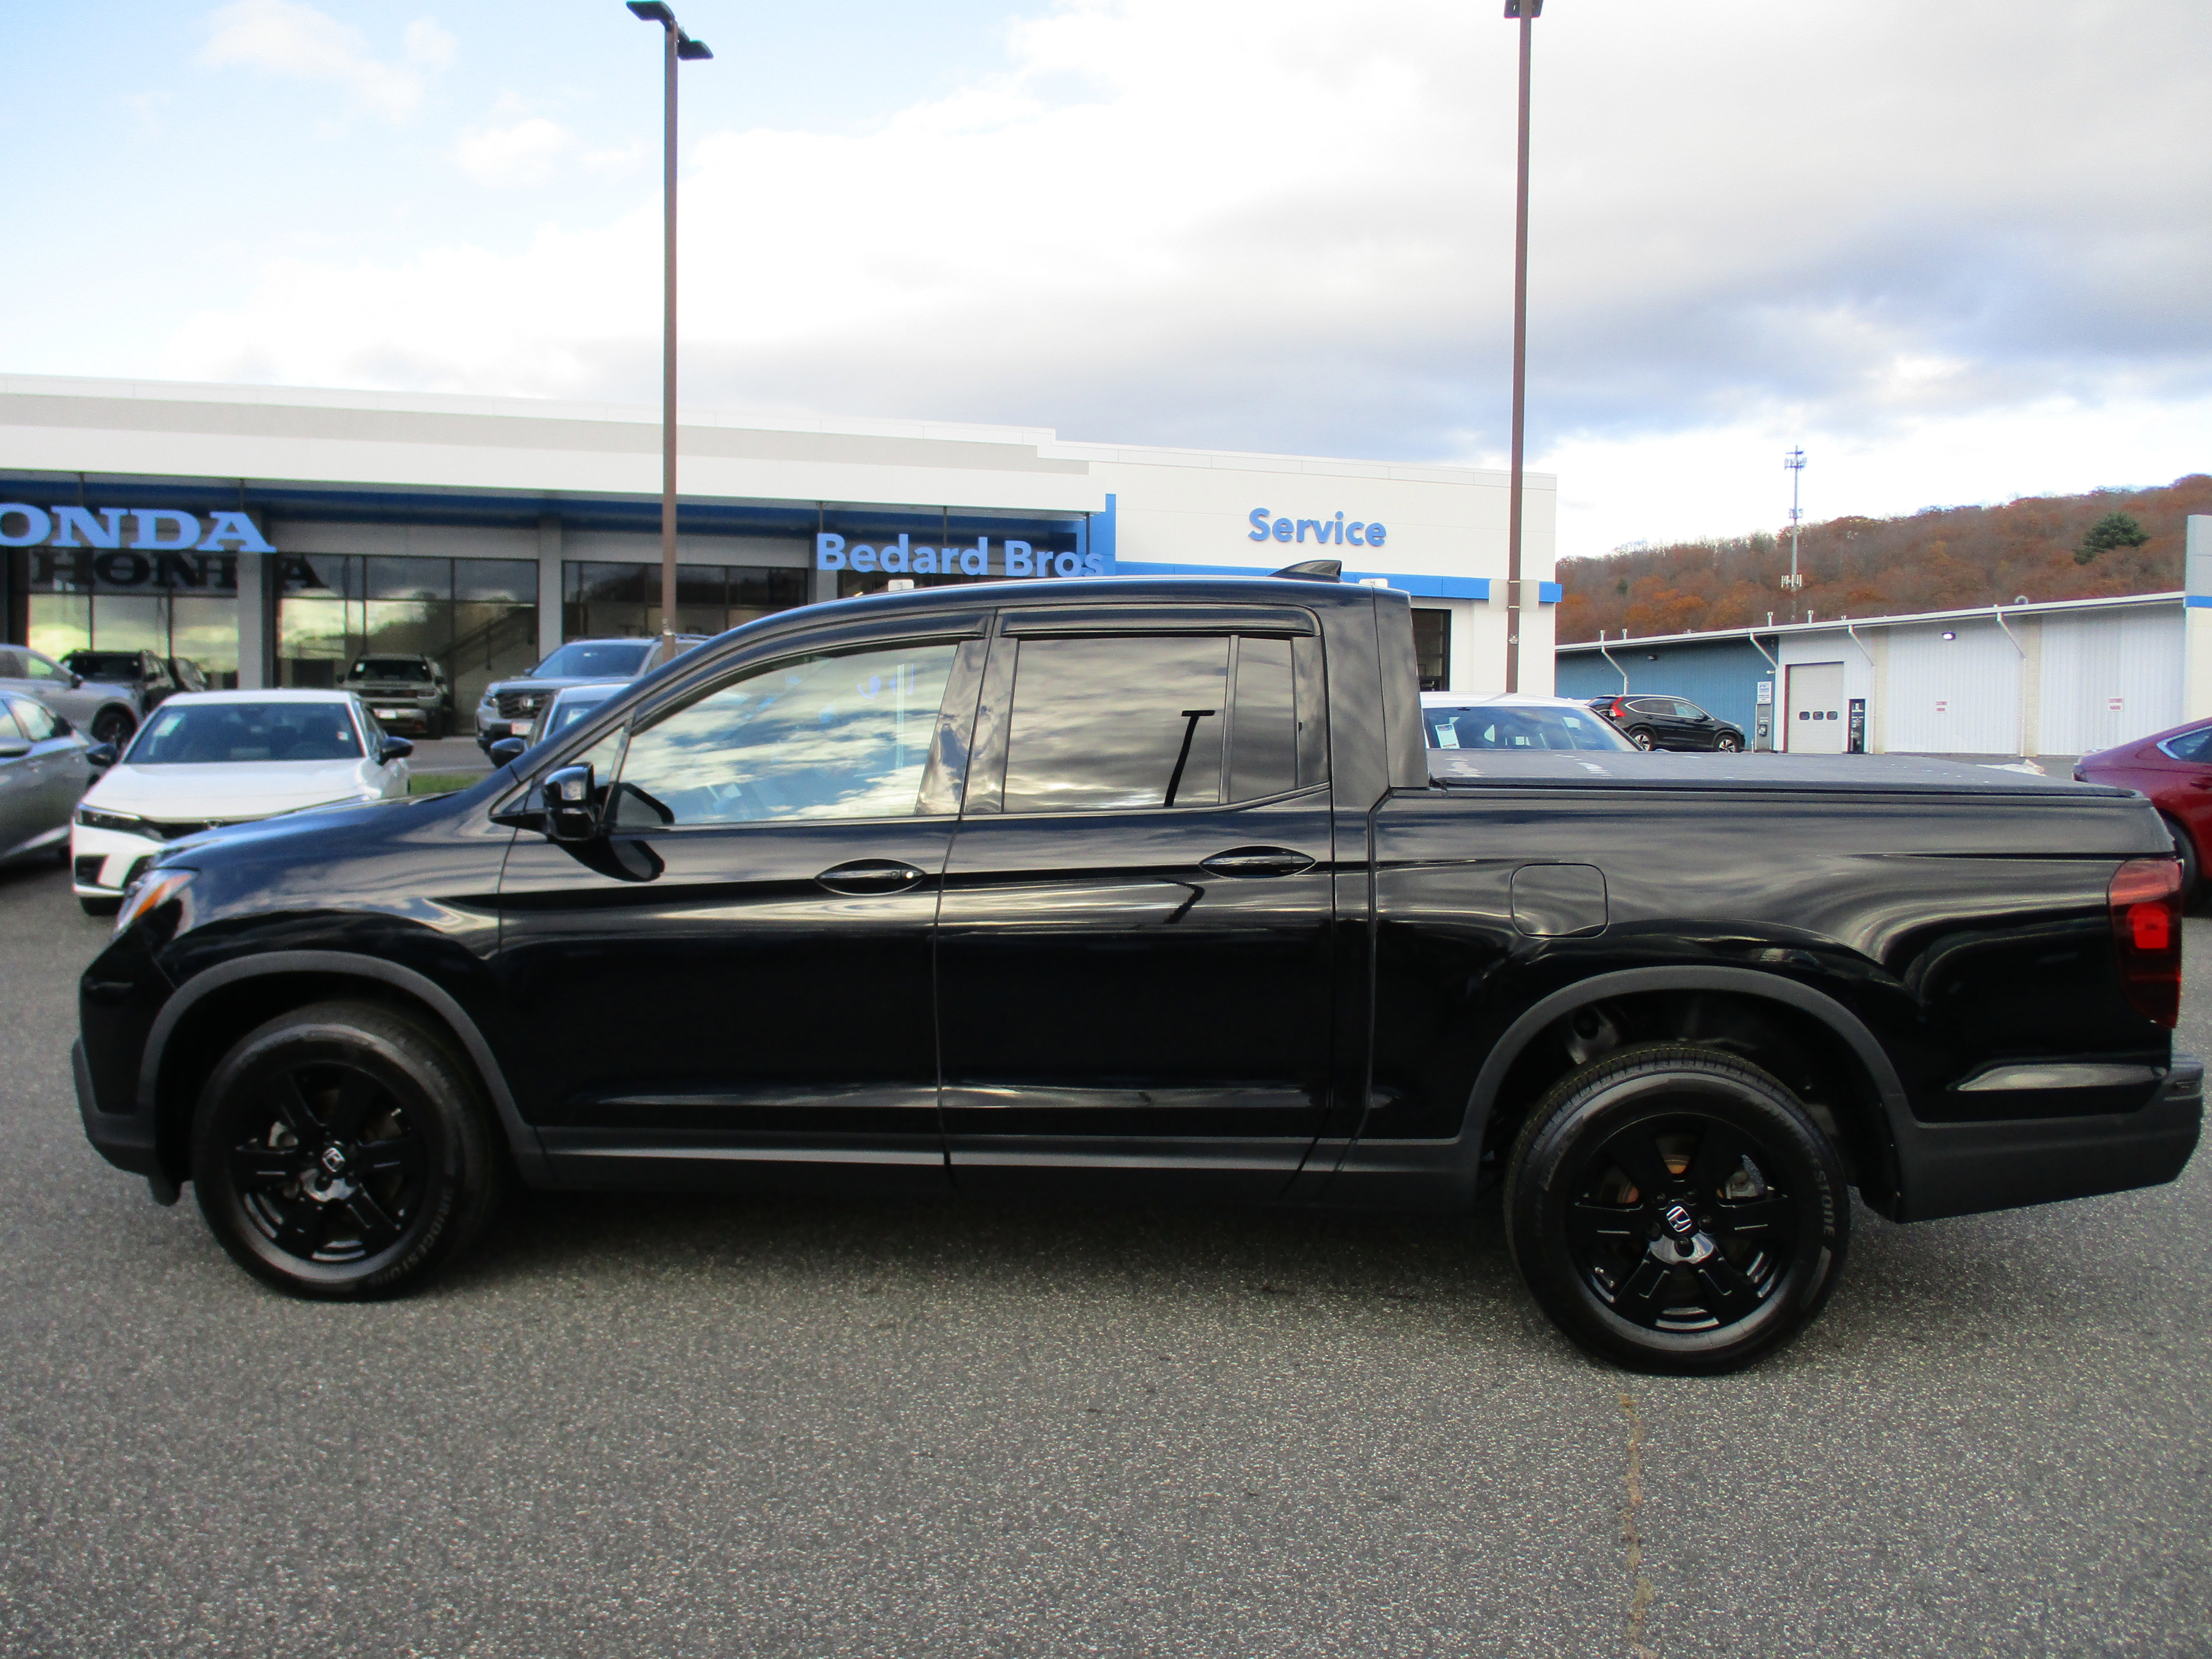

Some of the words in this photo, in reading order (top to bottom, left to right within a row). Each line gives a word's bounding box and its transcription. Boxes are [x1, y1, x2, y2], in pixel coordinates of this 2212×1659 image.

[1248, 507, 1387, 547] Service
[817, 532, 988, 575] Bedard
[1004, 540, 1104, 578] Bros
